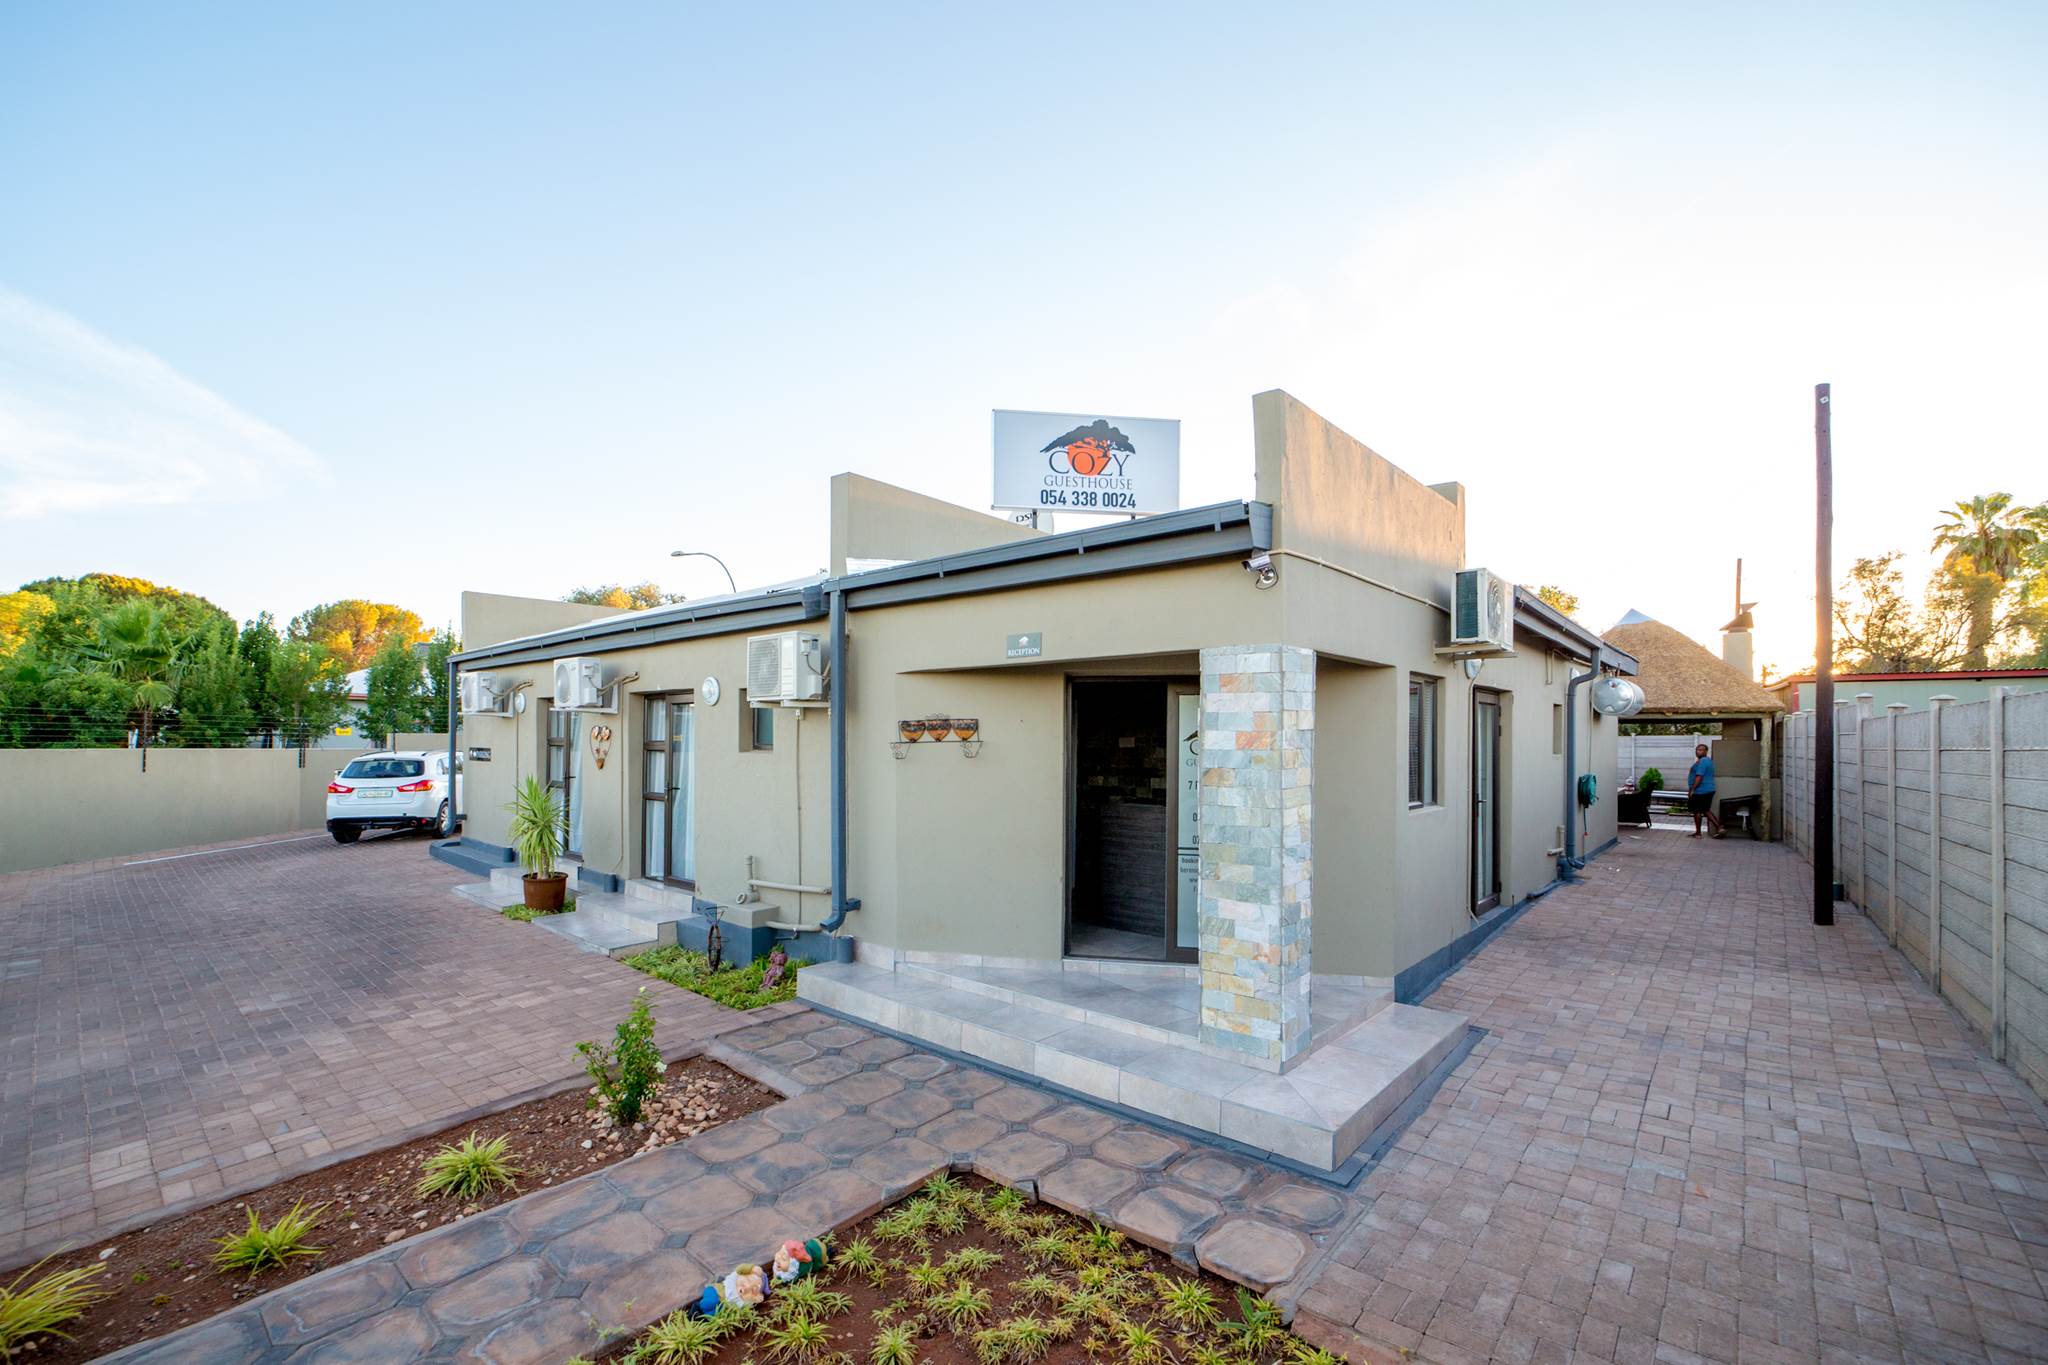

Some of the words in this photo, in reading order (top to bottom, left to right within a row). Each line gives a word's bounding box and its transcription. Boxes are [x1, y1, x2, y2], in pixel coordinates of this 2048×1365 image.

[1049, 450, 1130, 476] COZY
[1043, 474, 1133, 490] GUESTHOUSE
[1040, 489, 1067, 505] 054
[1072, 490, 1097, 507] 338
[1102, 492, 1136, 508] 0024
